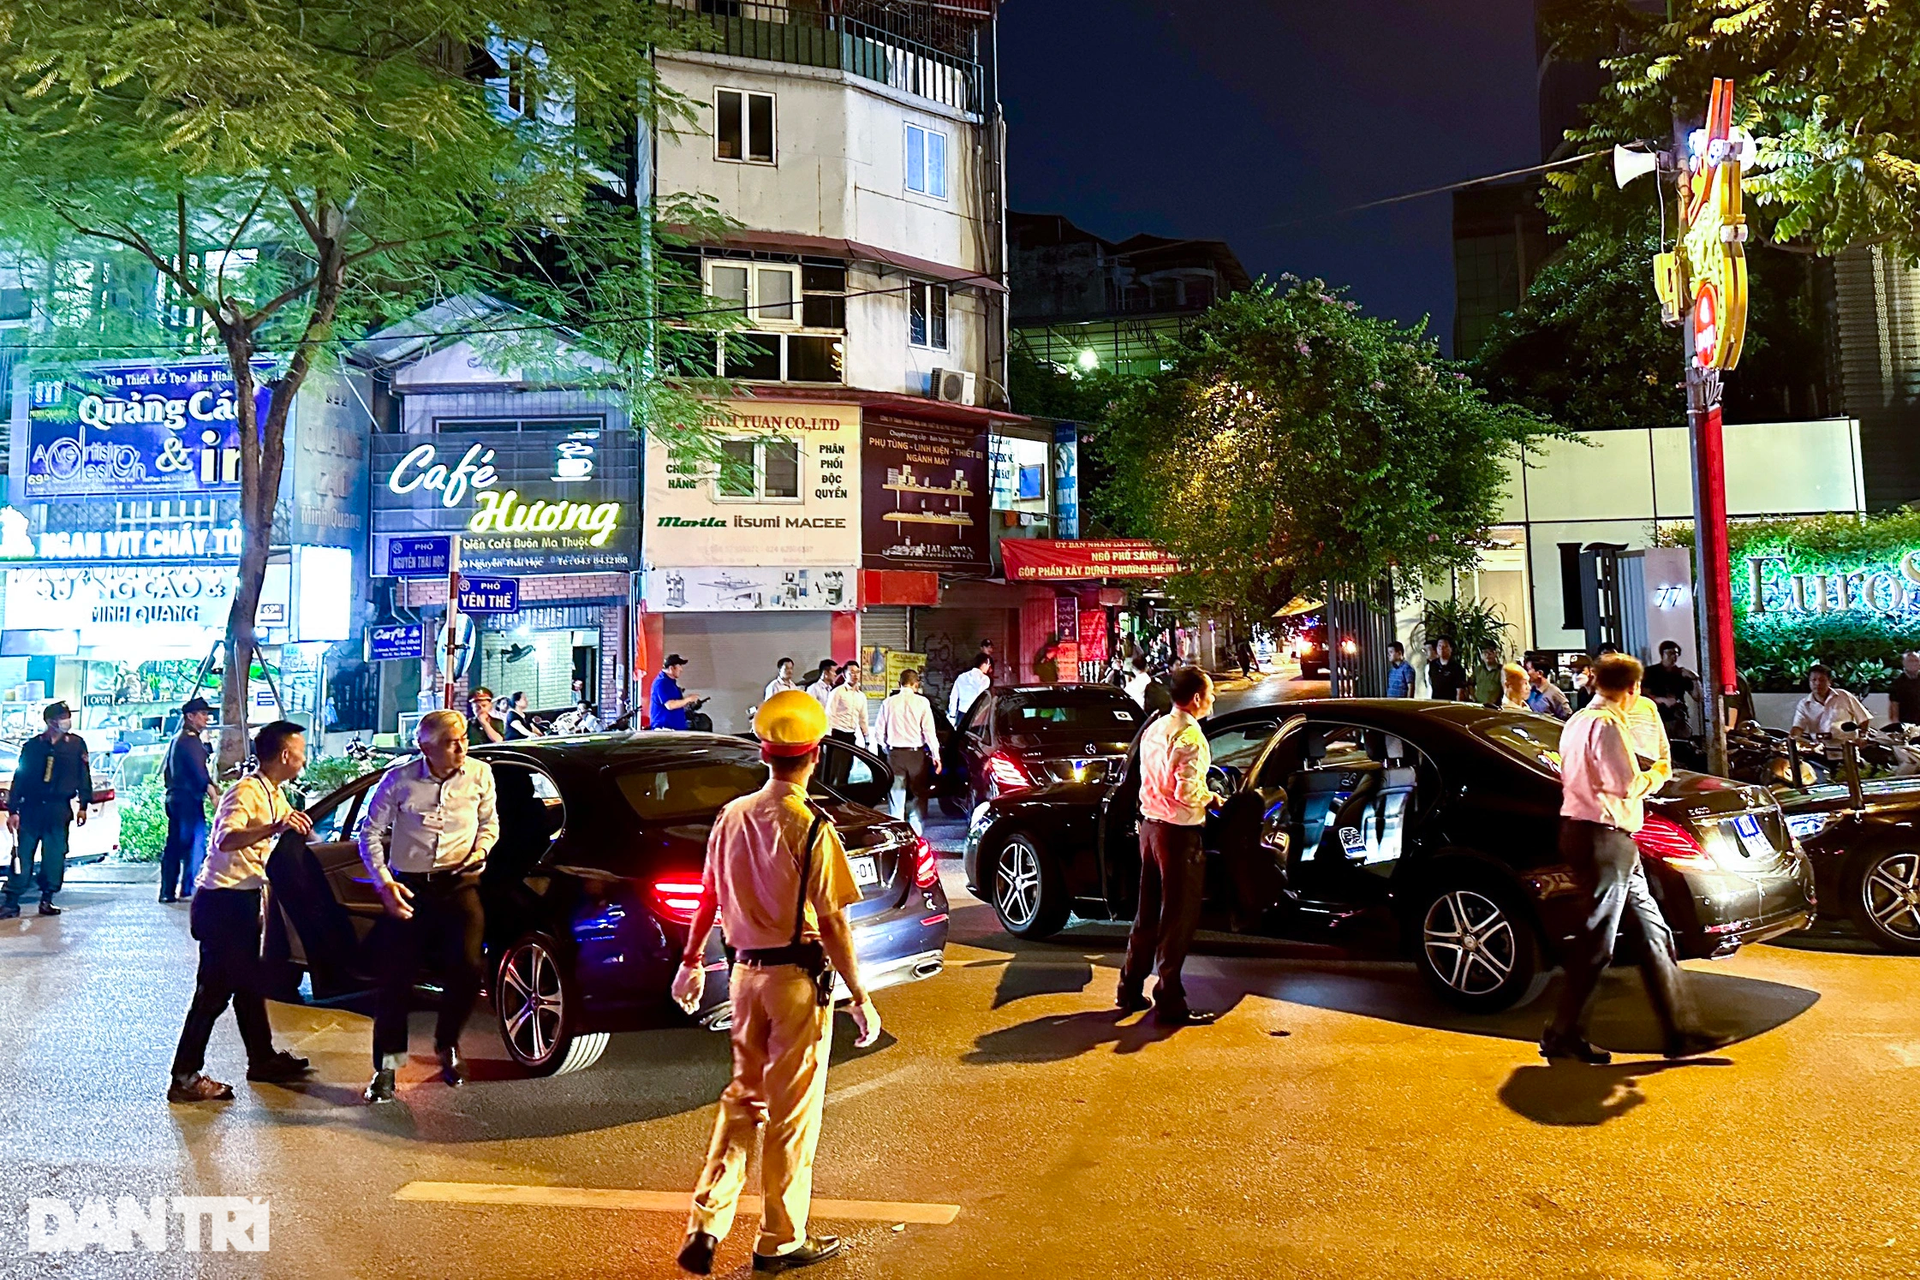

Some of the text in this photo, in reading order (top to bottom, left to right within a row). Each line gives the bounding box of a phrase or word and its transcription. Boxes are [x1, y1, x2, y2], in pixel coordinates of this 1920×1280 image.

[169, 372, 188, 385] Tạo
[79, 391, 188, 430] Quảng
[785, 416, 840, 433] CO.,LTD
[155, 437, 194, 472] &
[819, 443, 845, 455] PHÂN
[869, 437, 886, 449] PHỤ
[887, 438, 909, 450] TÙNG
[914, 443, 931, 453] LINH
[932, 444, 950, 456] KIỆN
[954, 446, 974, 459] THIẾT
[820, 456, 843, 469] PHỐI
[906, 452, 950, 466] NGÀNH MAY
[389, 443, 499, 507] Café
[821, 474, 842, 486] ĐỘC
[668, 478, 697, 490] HÃNG
[815, 486, 848, 499] QUYỀN
[301, 505, 362, 532] Minh Quang
[470, 490, 620, 546] Hương
[734, 515, 780, 529] itsumi
[785, 518, 846, 529] MACEE
[146, 522, 209, 556] CHÁY
[488, 537, 511, 549] Café
[514, 537, 539, 548] Buôn
[541, 537, 558, 547] Ma
[561, 536, 589, 549] Thuột
[418, 554, 432, 568] THÁI
[1091, 551, 1111, 562] NGÕ
[1112, 549, 1131, 561] PHỐ
[1133, 550, 1158, 561] SÁNG
[1018, 566, 1036, 577] GÓP
[1038, 565, 1063, 577] PHẦN
[1065, 564, 1082, 576] XÂY
[1085, 566, 1110, 578] DỰNG
[1111, 563, 1149, 575] PHƯỜNG
[481, 580, 501, 590] PHỐ
[461, 592, 512, 608] YÊN THẾ
[1656, 587, 1683, 608] 77
[92, 605, 199, 624] MINH QUANG
